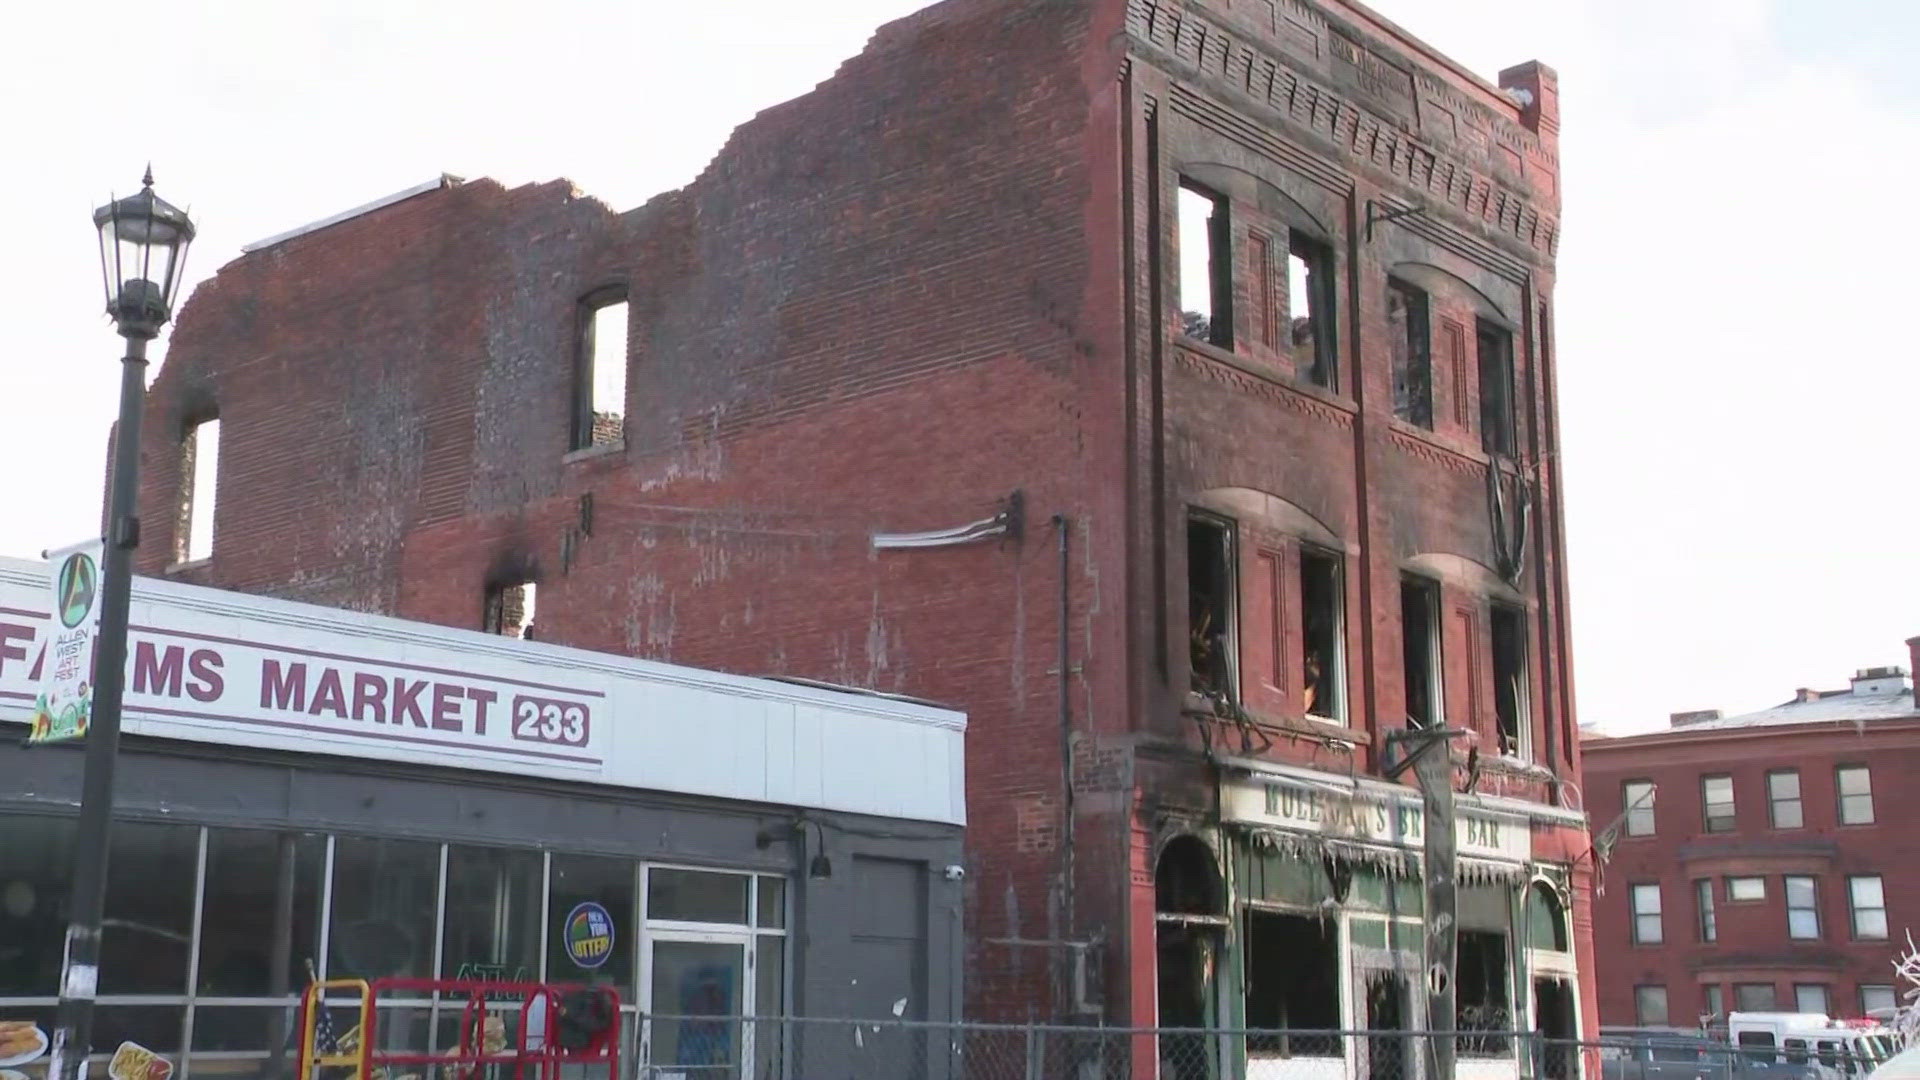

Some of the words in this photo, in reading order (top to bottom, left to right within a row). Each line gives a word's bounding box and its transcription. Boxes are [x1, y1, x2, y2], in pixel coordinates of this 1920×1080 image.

[55, 628, 89, 647] ALLEN
[56, 641, 85, 658] WEST
[58, 655, 79, 669] ART
[0, 622, 225, 703] FMS
[259, 658, 498, 736] MARKET
[517, 700, 586, 742] 233
[54, 667, 80, 682] FEST
[1467, 815, 1499, 849] BAR
